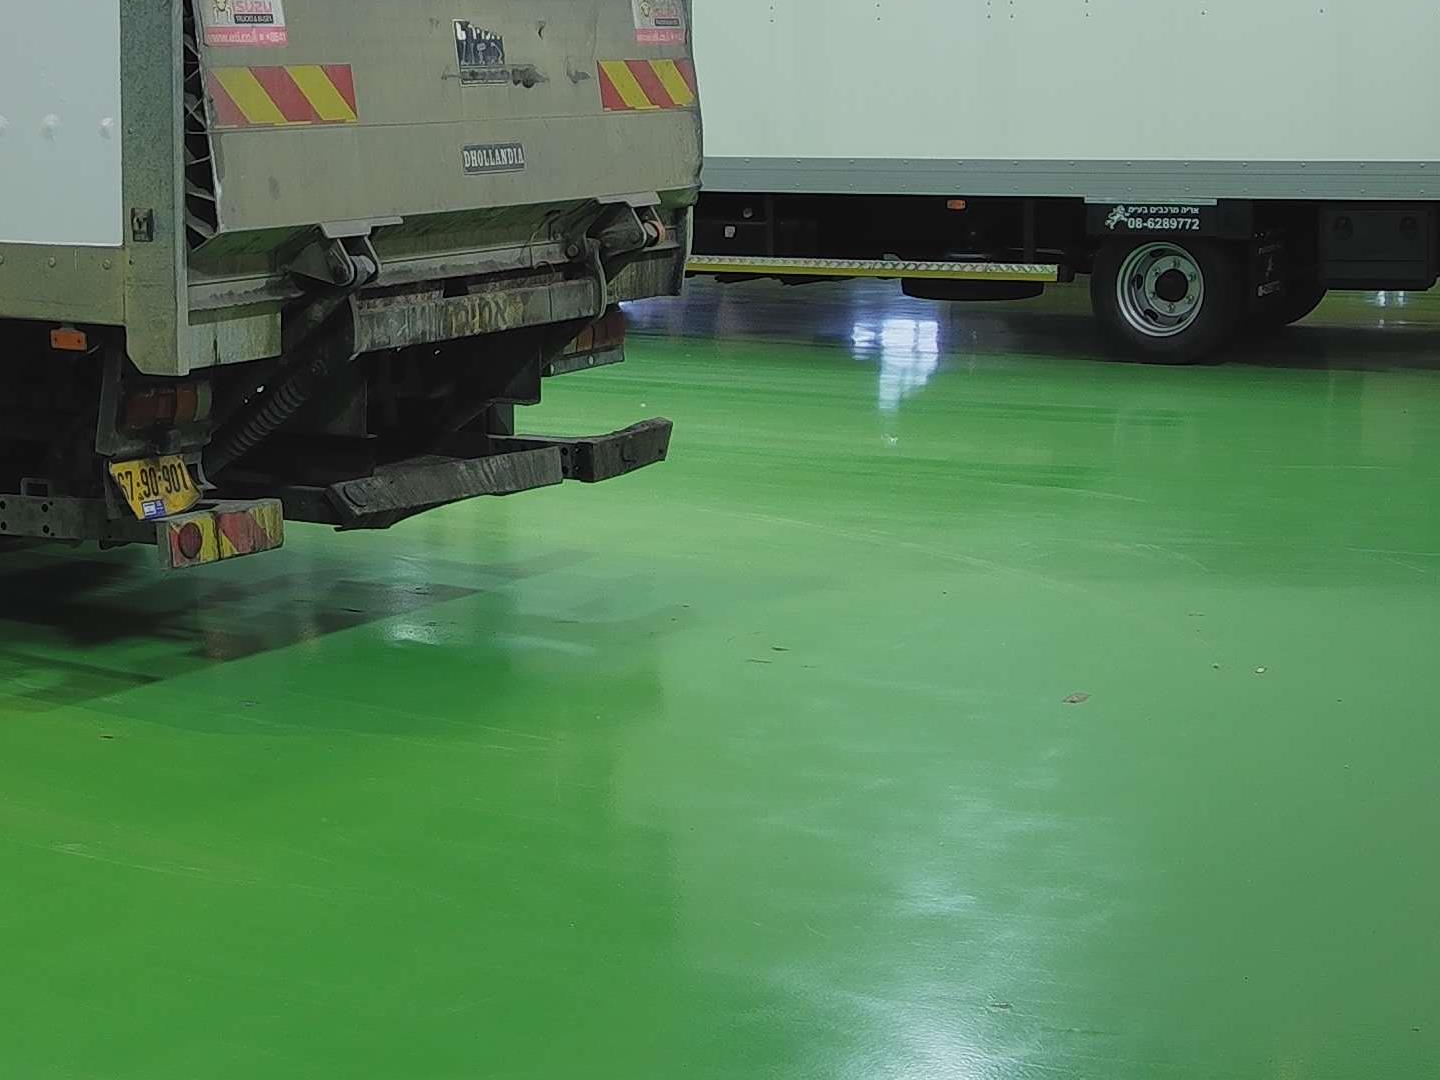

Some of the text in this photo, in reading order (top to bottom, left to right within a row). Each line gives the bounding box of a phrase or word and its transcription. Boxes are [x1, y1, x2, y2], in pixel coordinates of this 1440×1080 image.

[463, 148, 524, 167] DHOLLANDIA
[1150, 206, 1179, 214] מרכבים
[1127, 217, 1200, 230] 08-6289772
